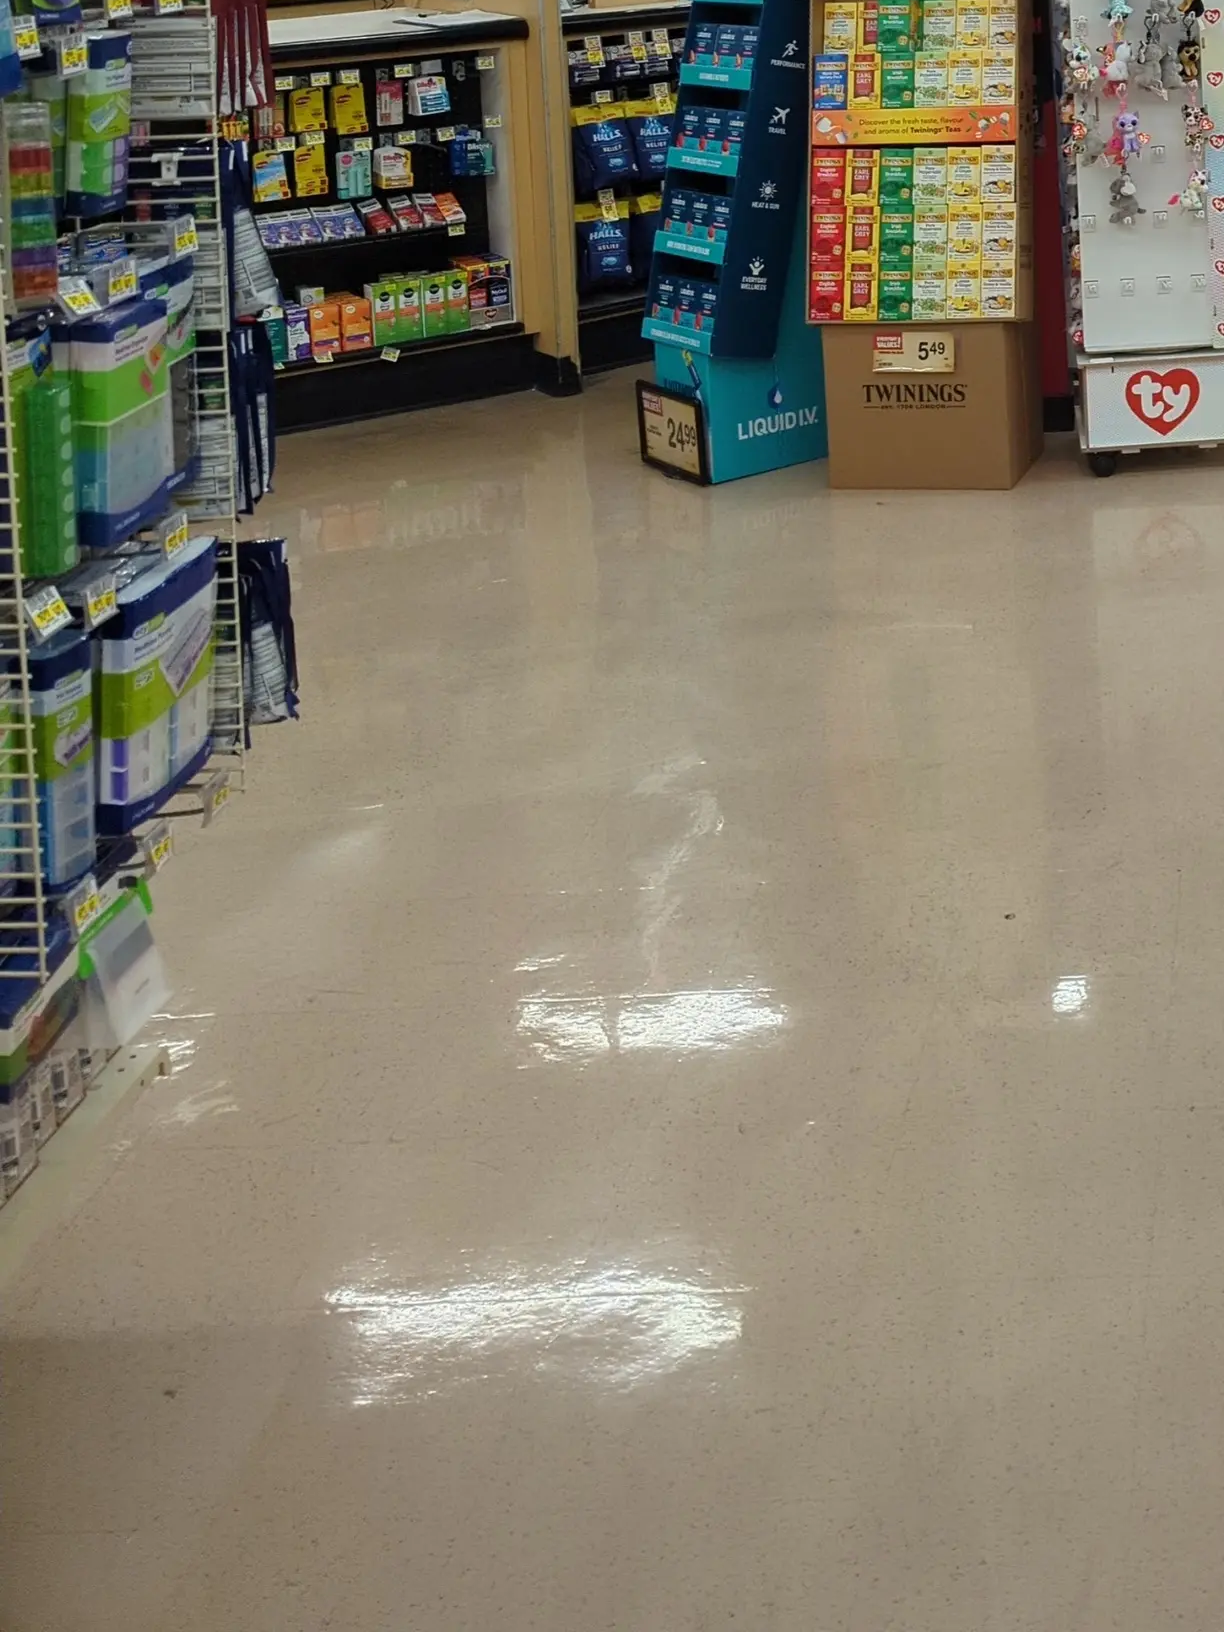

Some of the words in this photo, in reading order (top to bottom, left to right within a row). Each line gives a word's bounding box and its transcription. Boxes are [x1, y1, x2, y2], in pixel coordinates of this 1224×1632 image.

[859, 118, 888, 126] Discover
[890, 117, 901, 125] the
[902, 117, 920, 125] fresh
[864, 127, 876, 135] and
[901, 126, 909, 134] of
[945, 125, 961, 133] Teas
[593, 131, 621, 142] HALLS
[589, 229, 622, 240] HALLS
[862, 383, 966, 403] TWININGS
[1131, 374, 1192, 423] ty
[738, 411, 797, 440] LIQUID
[798, 406, 819, 426] I.V.
